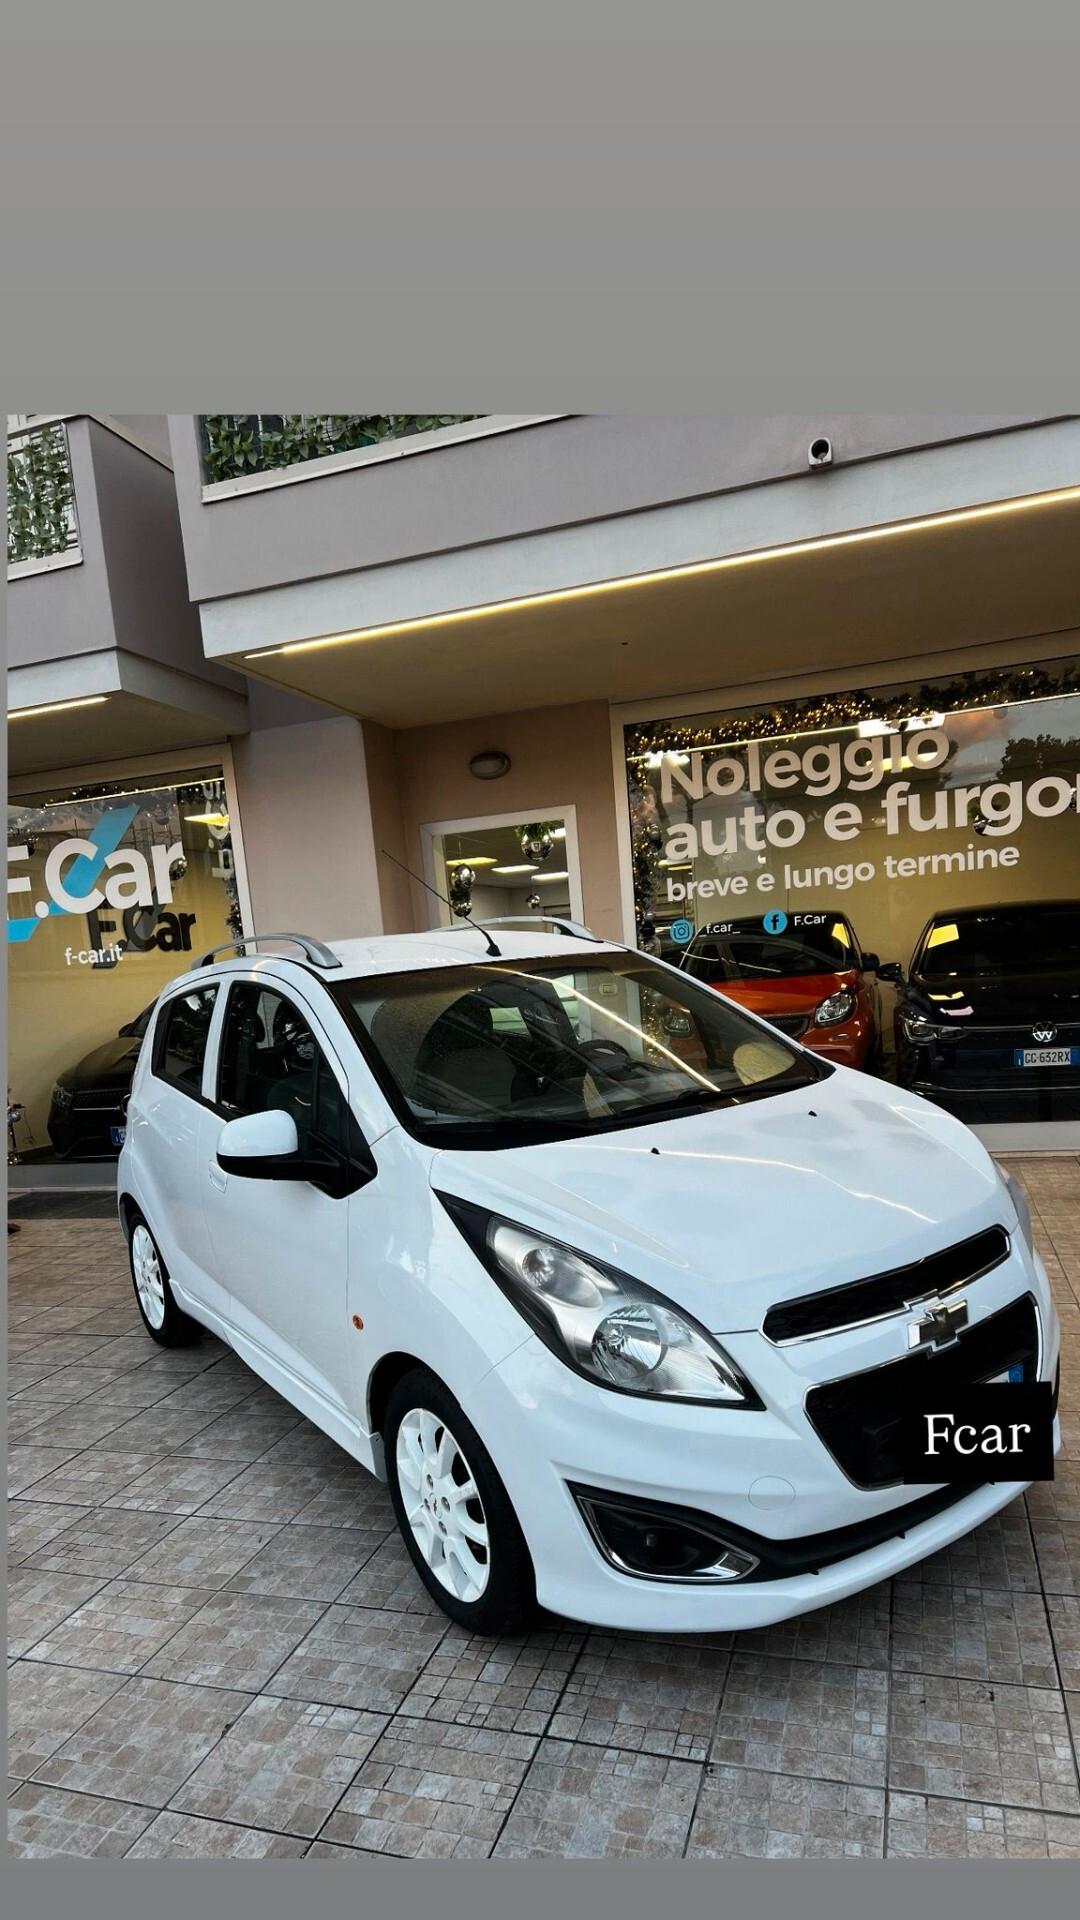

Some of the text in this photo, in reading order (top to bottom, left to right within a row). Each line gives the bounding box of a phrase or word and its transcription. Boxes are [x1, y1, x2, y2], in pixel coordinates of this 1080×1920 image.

[660, 730, 949, 802] Noleggio
[665, 773, 1080, 861] auto e furgo
[667, 843, 1020, 902] breve e lungo termine
[794, 914, 826, 927] F.Car
[64, 943, 123, 966] f-car.it
